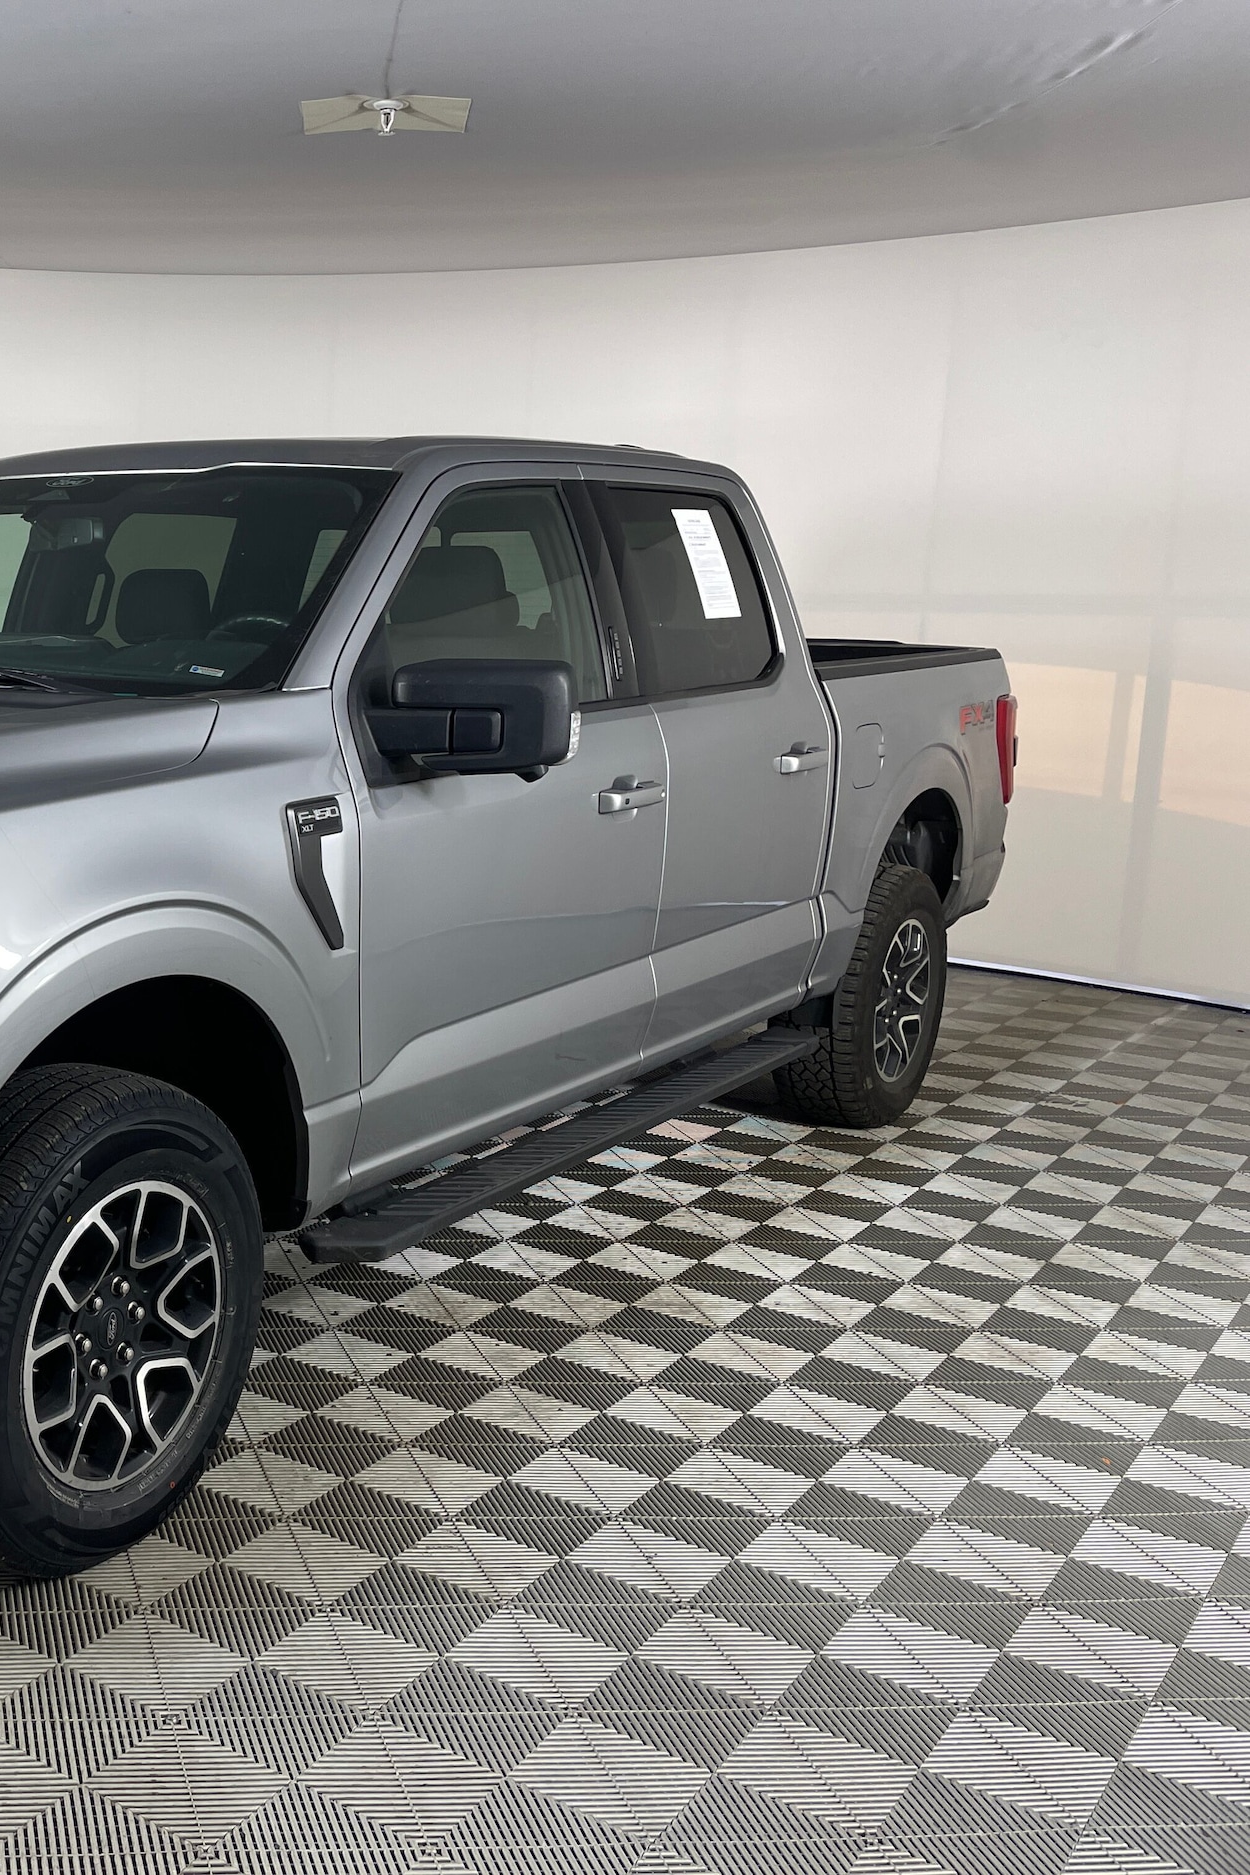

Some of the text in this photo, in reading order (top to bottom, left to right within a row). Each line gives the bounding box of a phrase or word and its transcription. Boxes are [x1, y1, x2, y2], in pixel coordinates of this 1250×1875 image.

[959, 699, 995, 735] FX4
[297, 805, 340, 824] F-150
[301, 824, 315, 833] XLT
